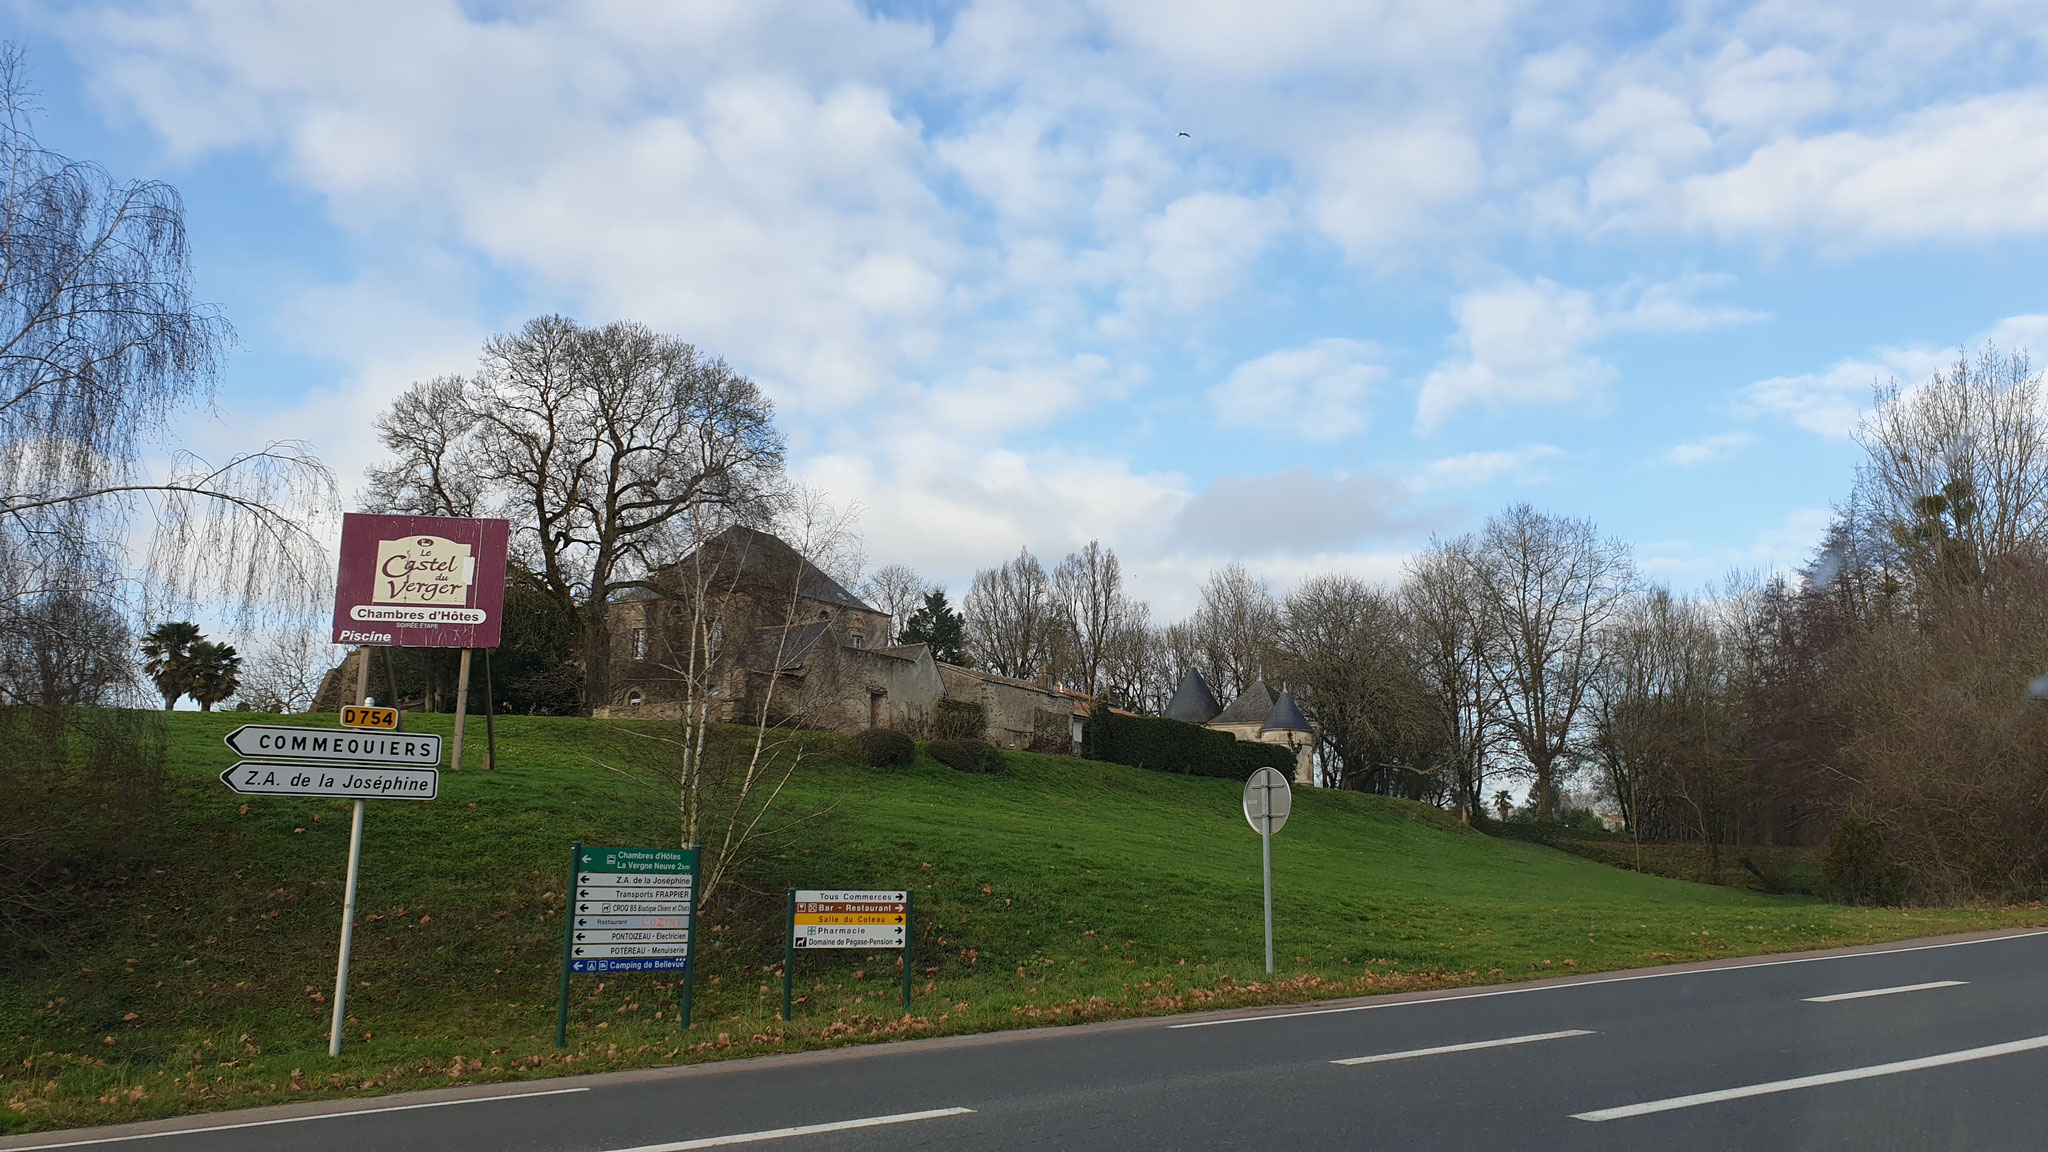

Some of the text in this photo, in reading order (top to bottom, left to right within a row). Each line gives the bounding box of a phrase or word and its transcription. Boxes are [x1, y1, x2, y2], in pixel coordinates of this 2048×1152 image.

[420, 549, 431, 557] Le
[382, 555, 457, 578] Castel
[435, 573, 449, 581] du
[387, 580, 462, 601] Verger
[357, 608, 479, 622] Chambres d'Hôtes
[340, 630, 392, 643] Piscine
[259, 734, 431, 757] COMMEQUIERS
[244, 770, 429, 794] Z.A. de la Joséphine
[618, 851, 681, 861] Chambres d'Hôtes
[617, 861, 627, 869] La
[628, 862, 653, 871] Vergne
[654, 862, 676, 870] Neuve
[616, 876, 631, 884] Z.A.
[652, 877, 690, 886] Joséphine
[616, 890, 653, 899] Transports
[845, 904, 892, 912] Restaurant
[611, 932, 651, 940] PONTOIZEAU
[808, 938, 836, 946] Domaine
[845, 938, 893, 947] Pégase-Pension
[610, 946, 646, 955] POTÉREAU
[651, 946, 685, 954] Menuiserie
[609, 960, 684, 970] Camping de Bellevue
